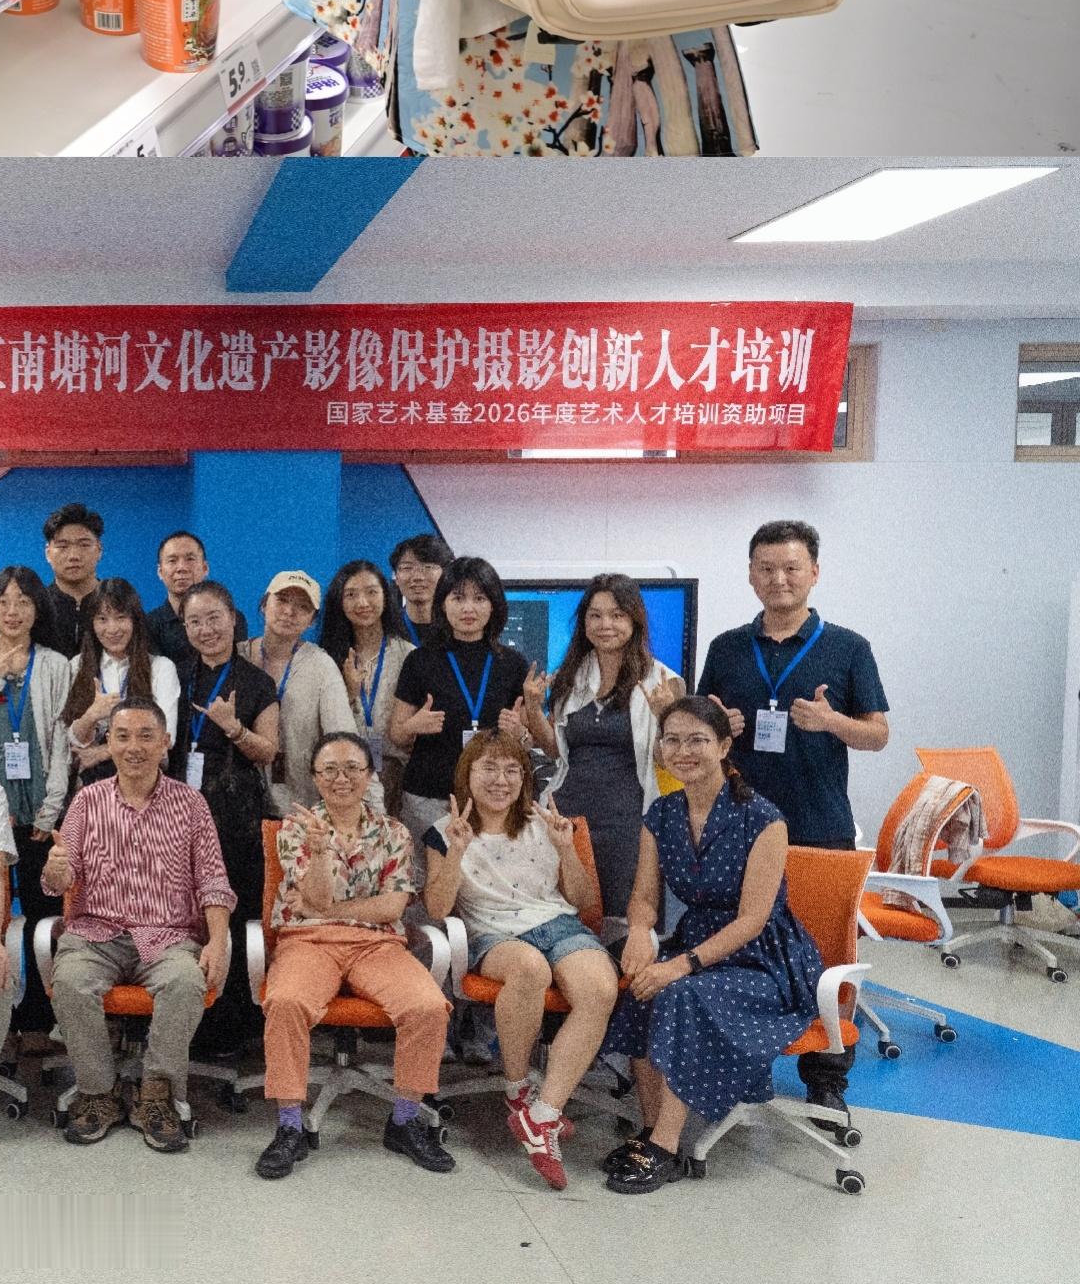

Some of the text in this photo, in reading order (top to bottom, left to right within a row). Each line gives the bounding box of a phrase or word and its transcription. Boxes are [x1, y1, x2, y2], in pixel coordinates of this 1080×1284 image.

[228, 60, 247, 98] 5.9
[326, 400, 806, 427] 国家艺术基金2026年度艺术人才培训资助项目
